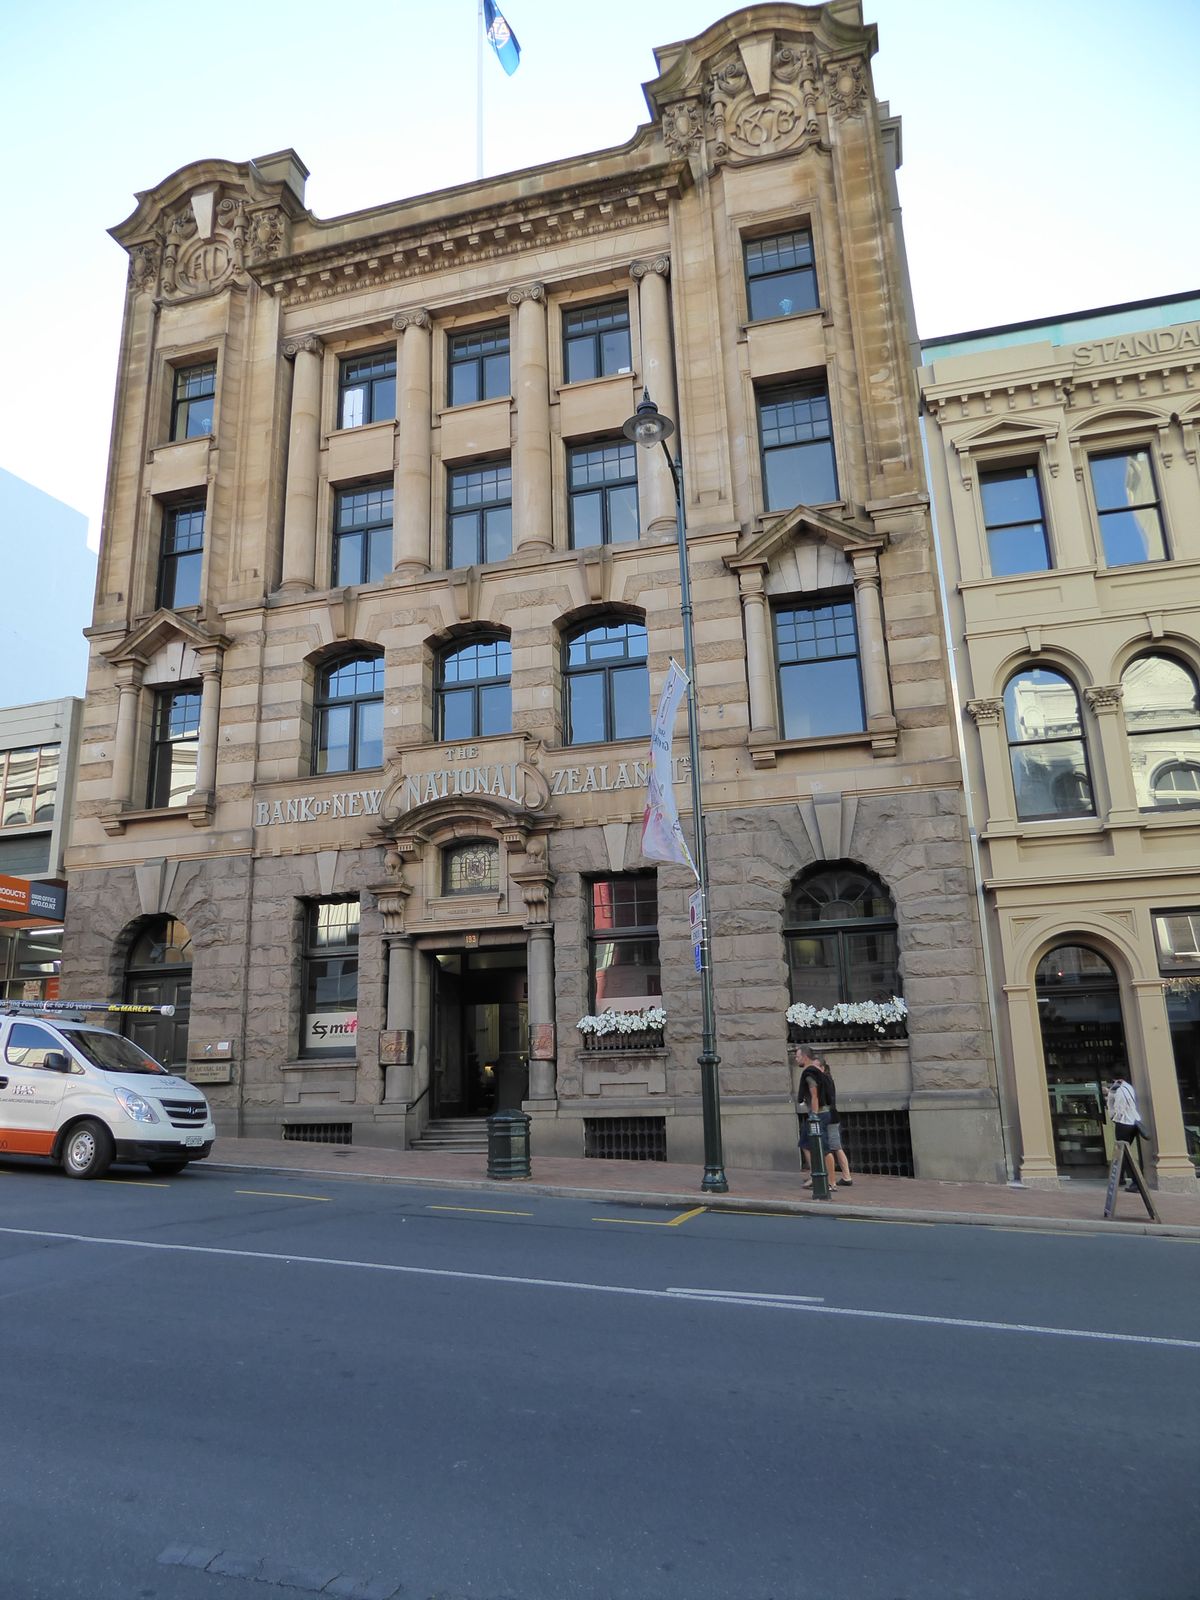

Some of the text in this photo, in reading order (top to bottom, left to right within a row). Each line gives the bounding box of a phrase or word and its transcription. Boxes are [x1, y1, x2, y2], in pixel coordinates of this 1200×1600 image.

[1073, 326, 1200, 366] STANDA
[445, 746, 479, 761] THE
[255, 796, 317, 827] BANK
[314, 800, 331, 815] OF
[332, 789, 386, 819] NEW
[551, 760, 650, 796] ZEALAN
[404, 763, 524, 811] NATIONAL
